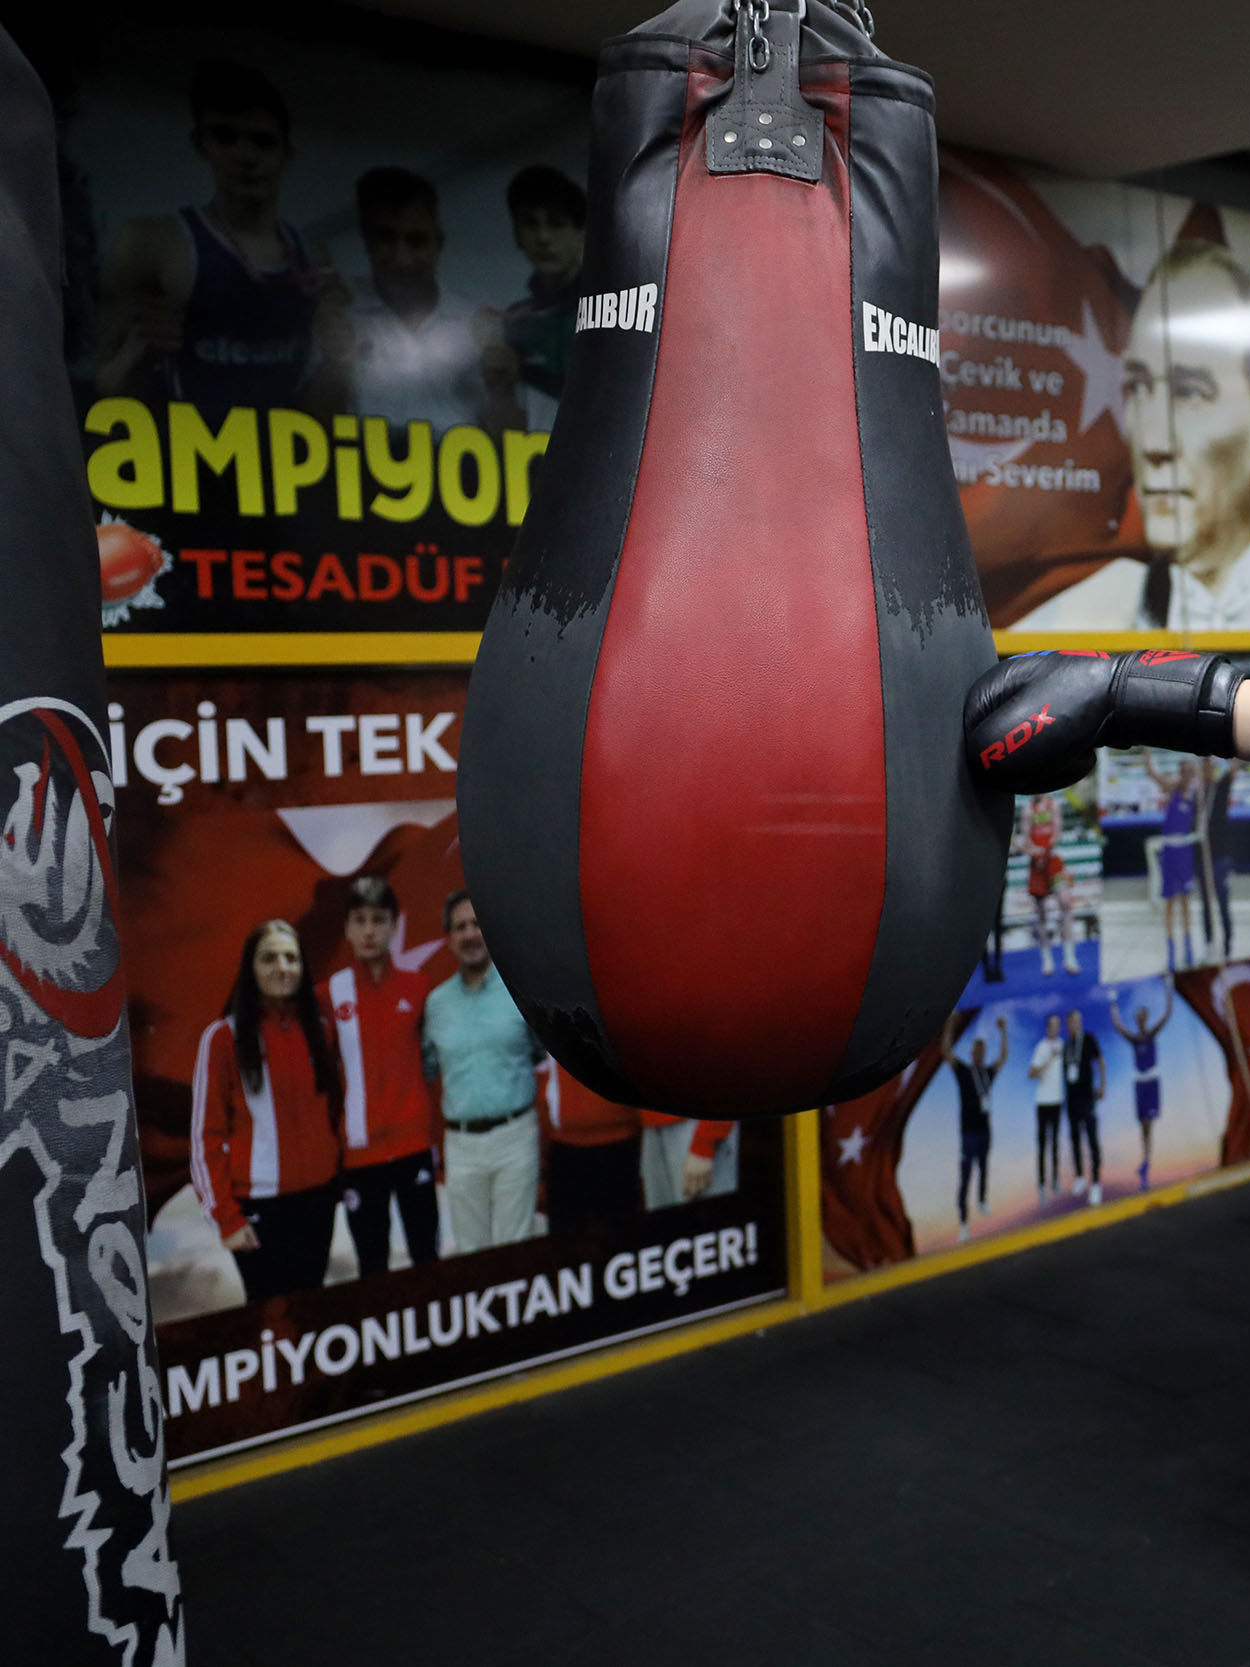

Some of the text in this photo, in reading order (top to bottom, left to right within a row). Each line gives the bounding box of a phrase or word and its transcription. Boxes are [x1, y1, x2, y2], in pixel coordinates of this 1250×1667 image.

[576, 283, 658, 333] ALIBUR
[1028, 368, 1064, 396] ve
[944, 402, 1068, 443] amanda
[984, 454, 1101, 492] Severim
[180, 544, 484, 601] TESADÜF
[108, 700, 457, 804] İÇİN TEK
[980, 704, 1056, 769] RDX
[160, 1224, 758, 1421] MPİYONLUKTAN GEÇER!
